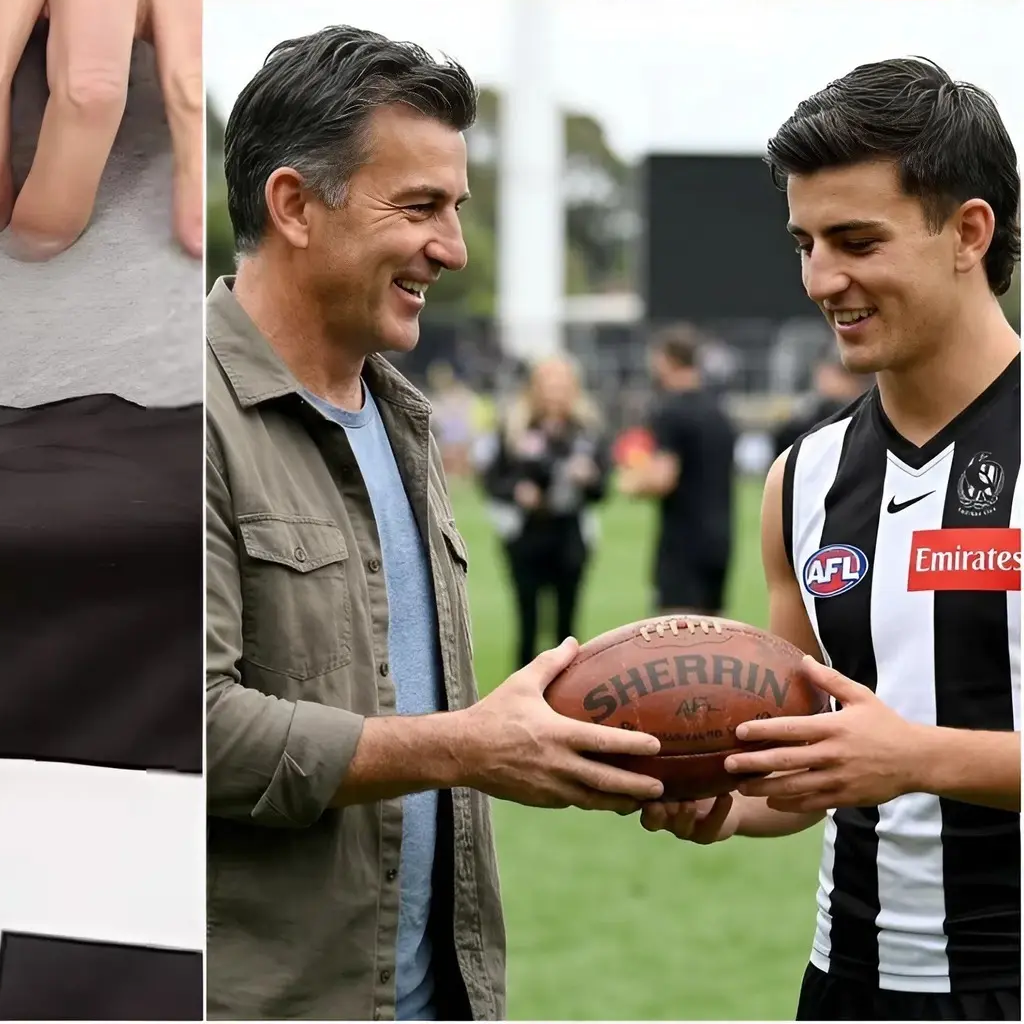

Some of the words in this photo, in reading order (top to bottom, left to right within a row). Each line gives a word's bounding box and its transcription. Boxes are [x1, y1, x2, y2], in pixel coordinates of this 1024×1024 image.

[807, 555, 860, 586] AFL
[915, 544, 1022, 572] Emirates
[582, 654, 791, 724] SHERRIN
